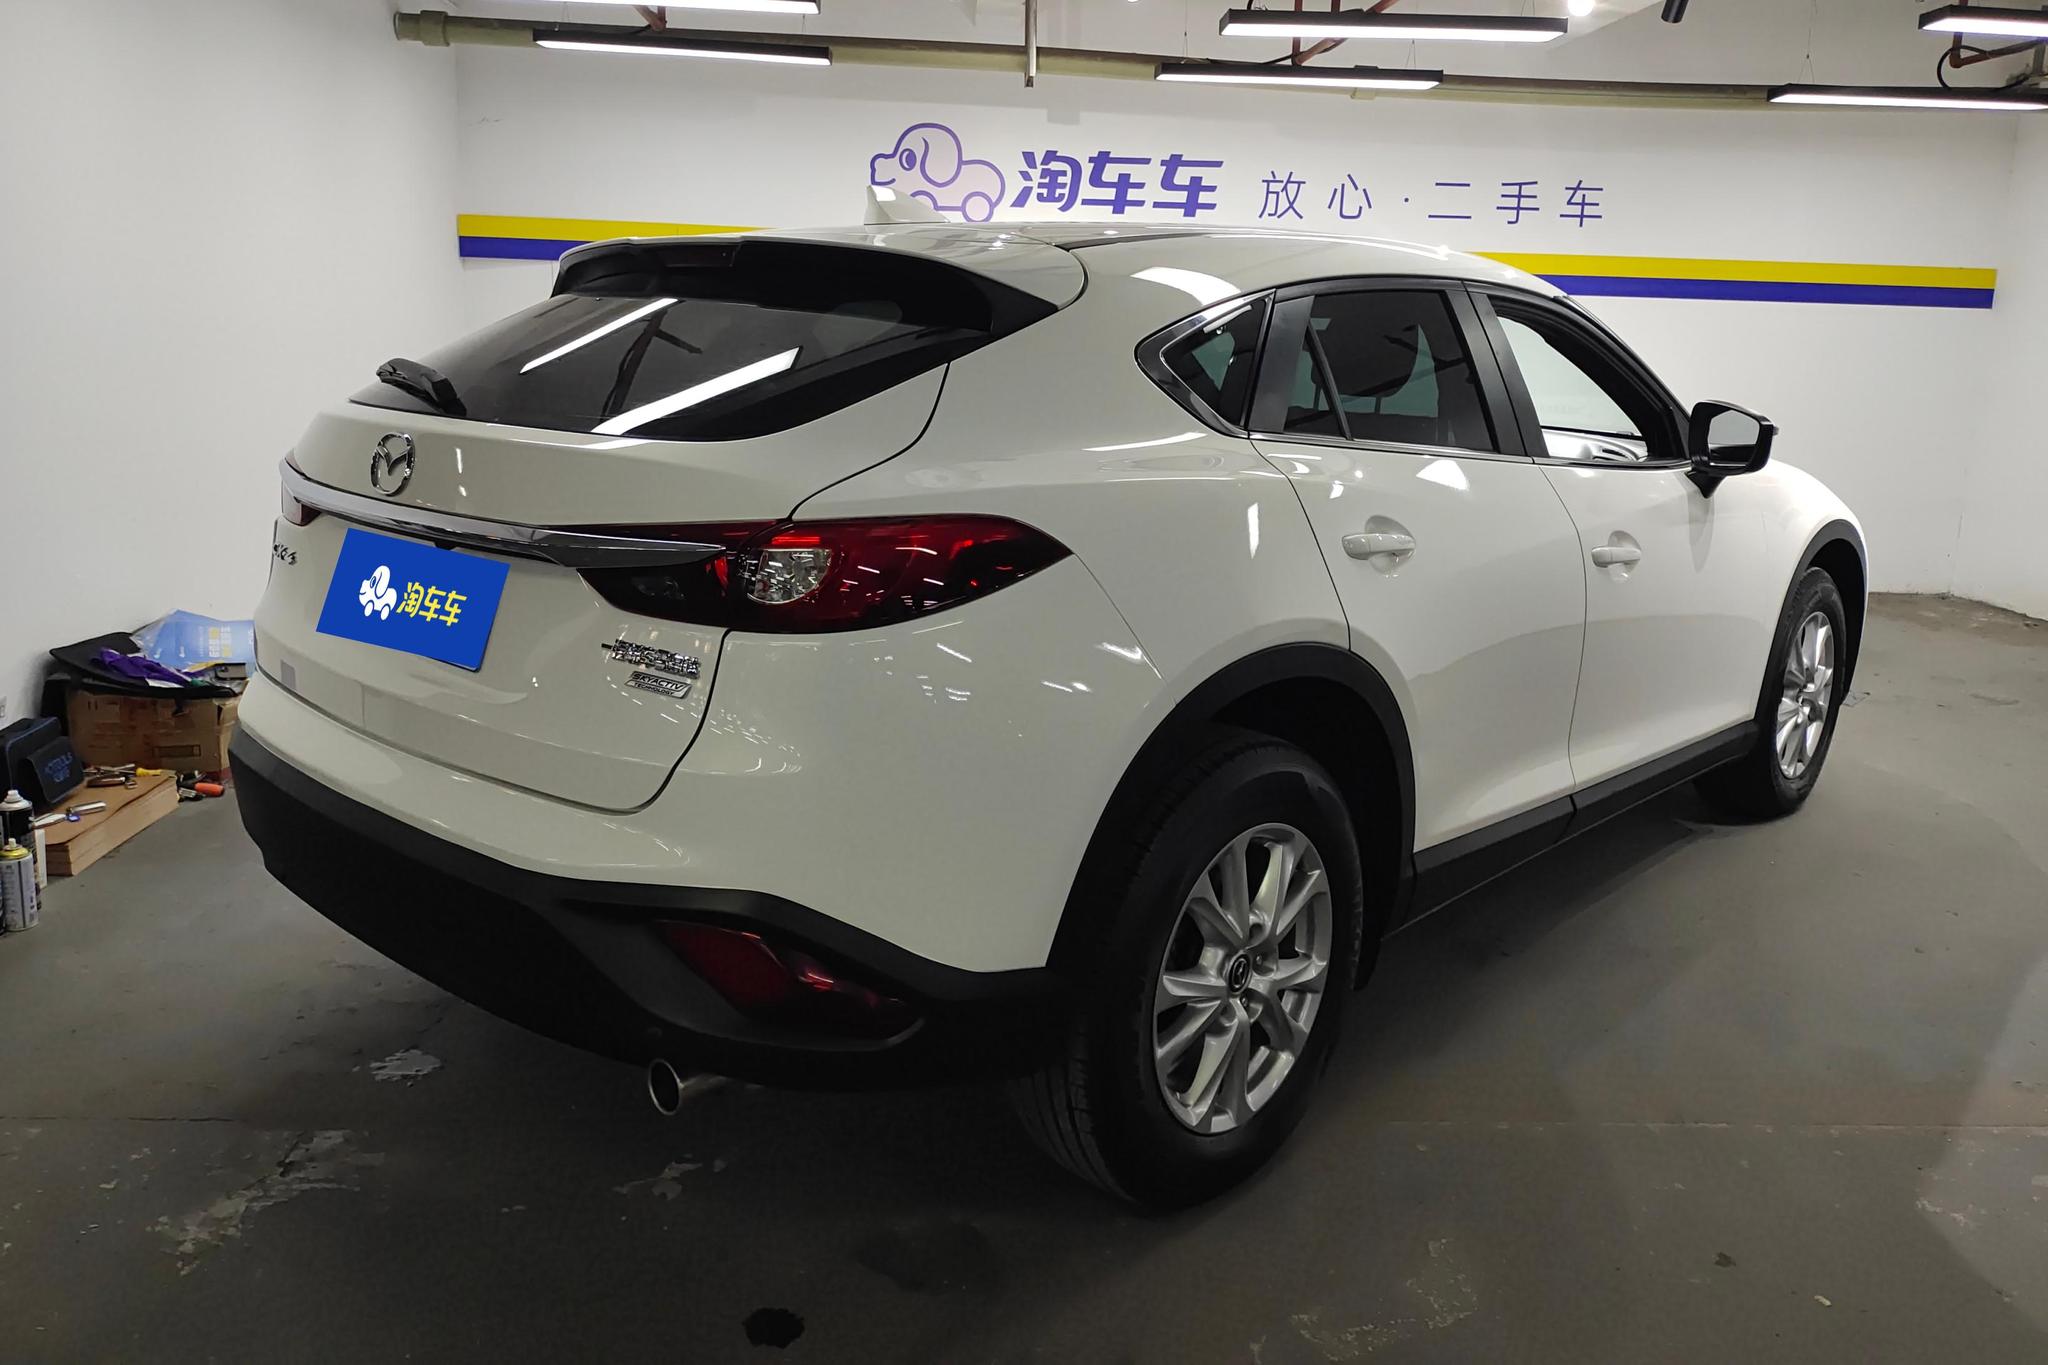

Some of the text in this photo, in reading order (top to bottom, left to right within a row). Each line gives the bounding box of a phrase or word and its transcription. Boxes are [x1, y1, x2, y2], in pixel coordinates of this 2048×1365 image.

[1009, 150, 1224, 218] 淘车车
[632, 672, 684, 690] SKYACTIV
[635, 682, 674, 696] TECHNOLOGY
